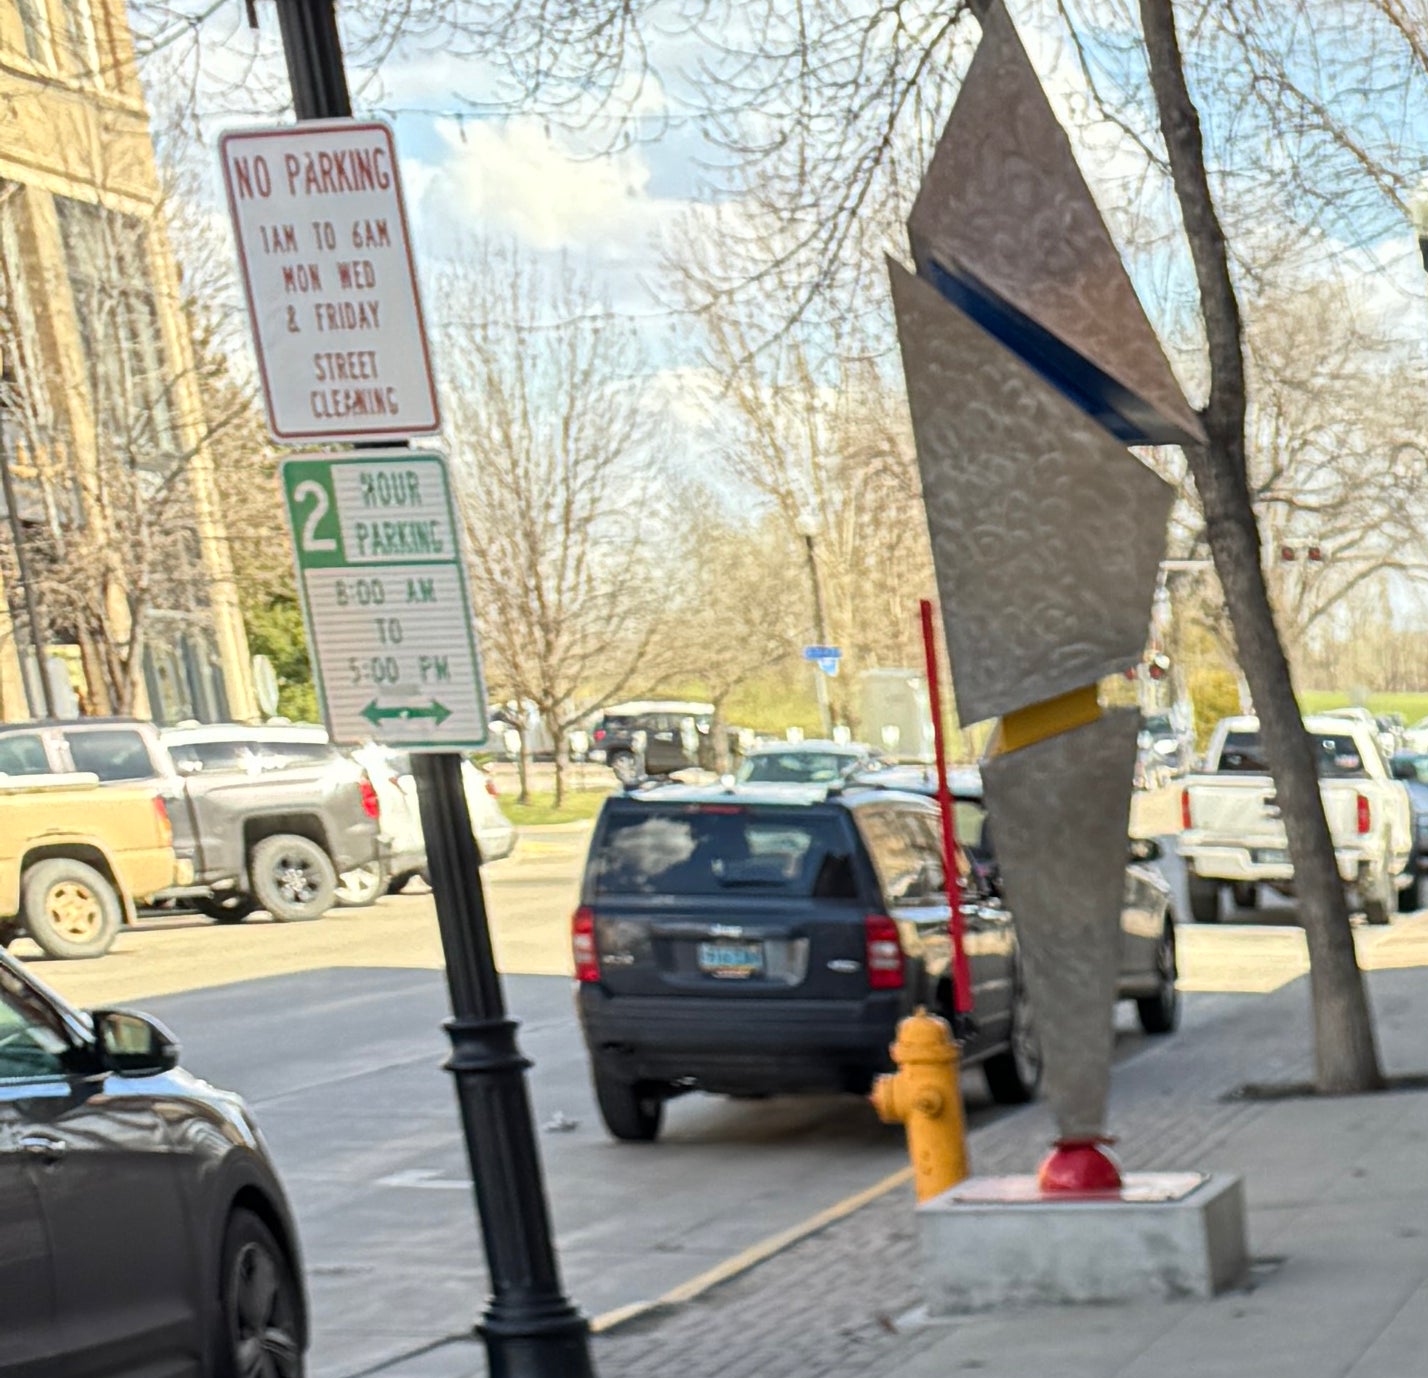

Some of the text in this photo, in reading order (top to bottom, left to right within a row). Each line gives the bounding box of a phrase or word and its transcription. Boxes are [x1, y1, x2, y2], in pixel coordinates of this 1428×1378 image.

[233, 147, 390, 199] NO PARKING
[259, 218, 391, 254] 1AM TO 6AM
[282, 260, 376, 293] MON WED
[286, 300, 381, 333] & FRIDAY
[314, 351, 378, 381] STREET
[310, 386, 399, 418] CLEANING
[360, 470, 422, 507] HOUR
[294, 479, 337, 551] 2
[355, 520, 444, 555] PARKING
[406, 578, 437, 603] AM
[373, 618, 403, 644] TO
[347, 655, 451, 684] 5:00 PM
